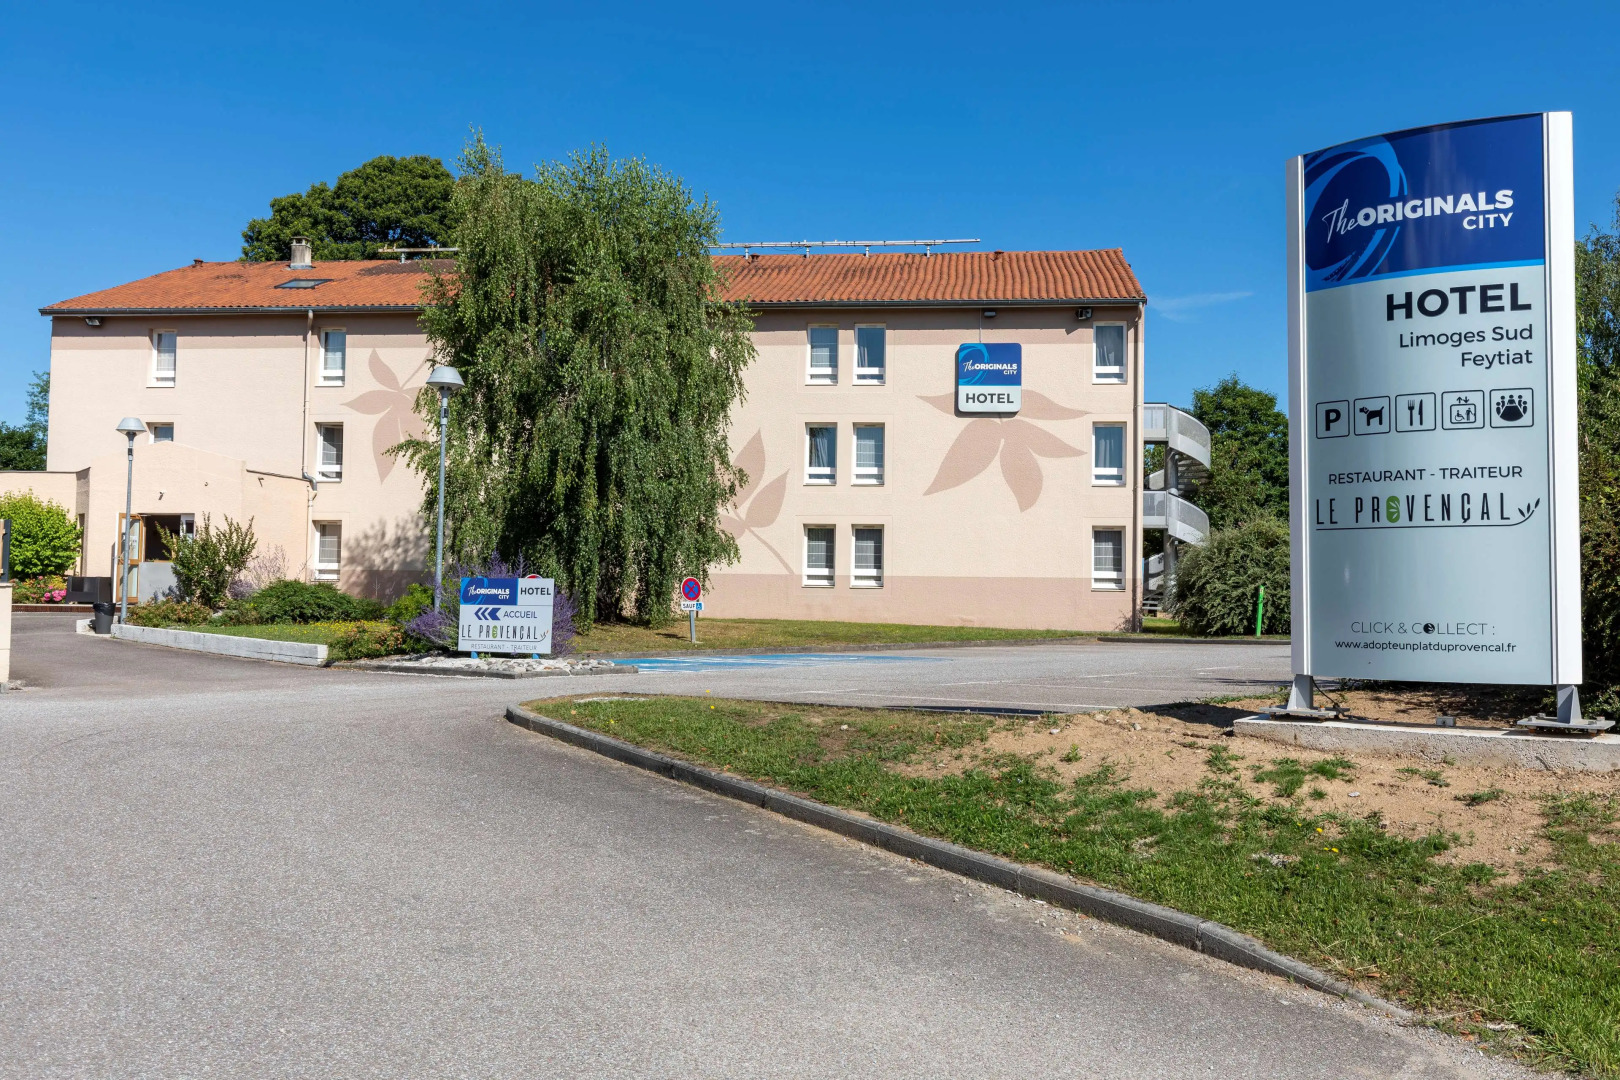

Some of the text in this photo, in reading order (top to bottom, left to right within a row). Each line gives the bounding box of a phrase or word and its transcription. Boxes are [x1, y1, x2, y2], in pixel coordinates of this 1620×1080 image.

[1462, 212, 1514, 230] CITY
[1386, 283, 1532, 321] HOTEL
[1399, 323, 1534, 349] Limoges Sud
[1460, 348, 1534, 370] Feytiat
[965, 393, 1014, 404] HOTEL
[1328, 468, 1426, 485] RESTAURANT
[1439, 466, 1523, 479] TRAITEUR
[1316, 492, 1511, 525] LE PROVENÇAL
[520, 587, 551, 595] HOTEL
[462, 624, 472, 638] LE
[1351, 621, 1394, 635] CLICK
[1397, 623, 1408, 635] &
[1411, 622, 1488, 636] COLLECT
[1334, 640, 1517, 653] www.adopteunplatduprovencal.fr
